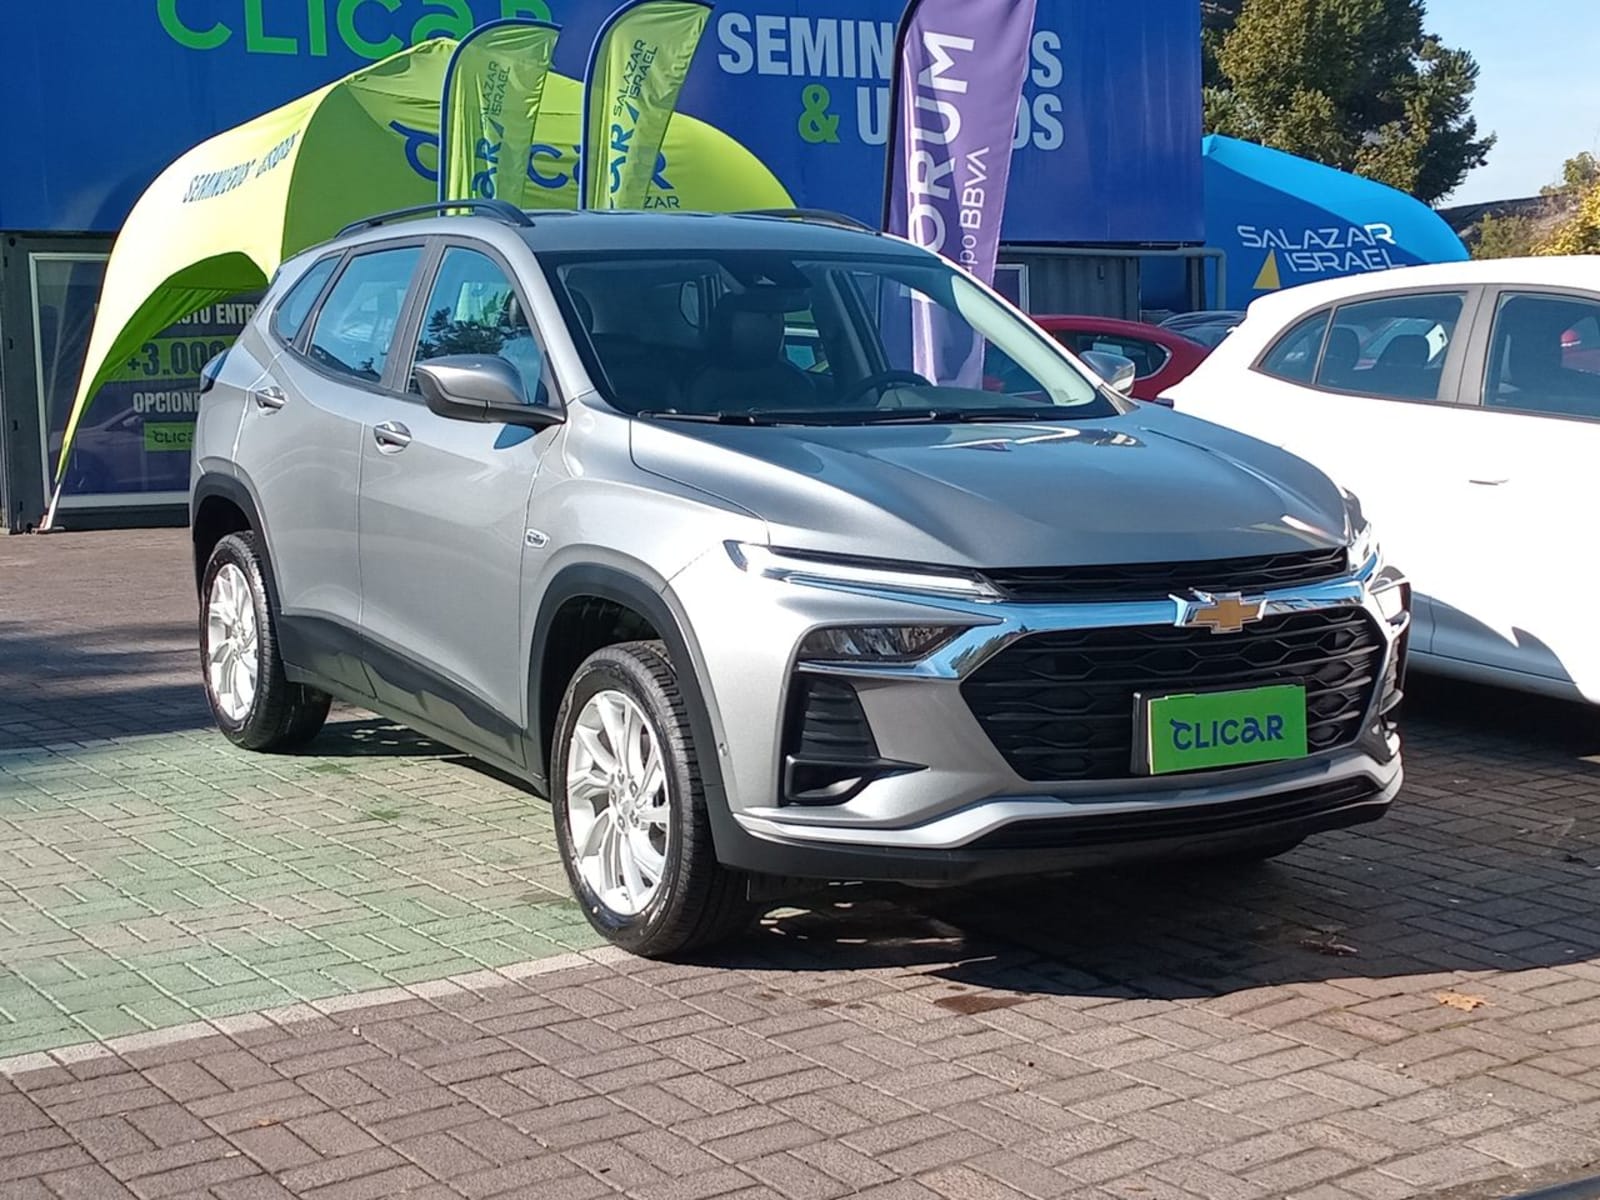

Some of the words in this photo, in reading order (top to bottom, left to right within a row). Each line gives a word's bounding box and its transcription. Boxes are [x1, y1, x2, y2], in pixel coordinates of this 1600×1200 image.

[490, 66, 510, 117] ISRAEL
[613, 39, 646, 117] SALAZAR
[629, 46, 658, 100] ISRAEL
[797, 83, 840, 144] &
[908, 31, 975, 254] ORUM
[960, 147, 990, 229] BBVA
[1236, 223, 1397, 250] SALAZAR
[1284, 248, 1407, 273] ISRAEL
